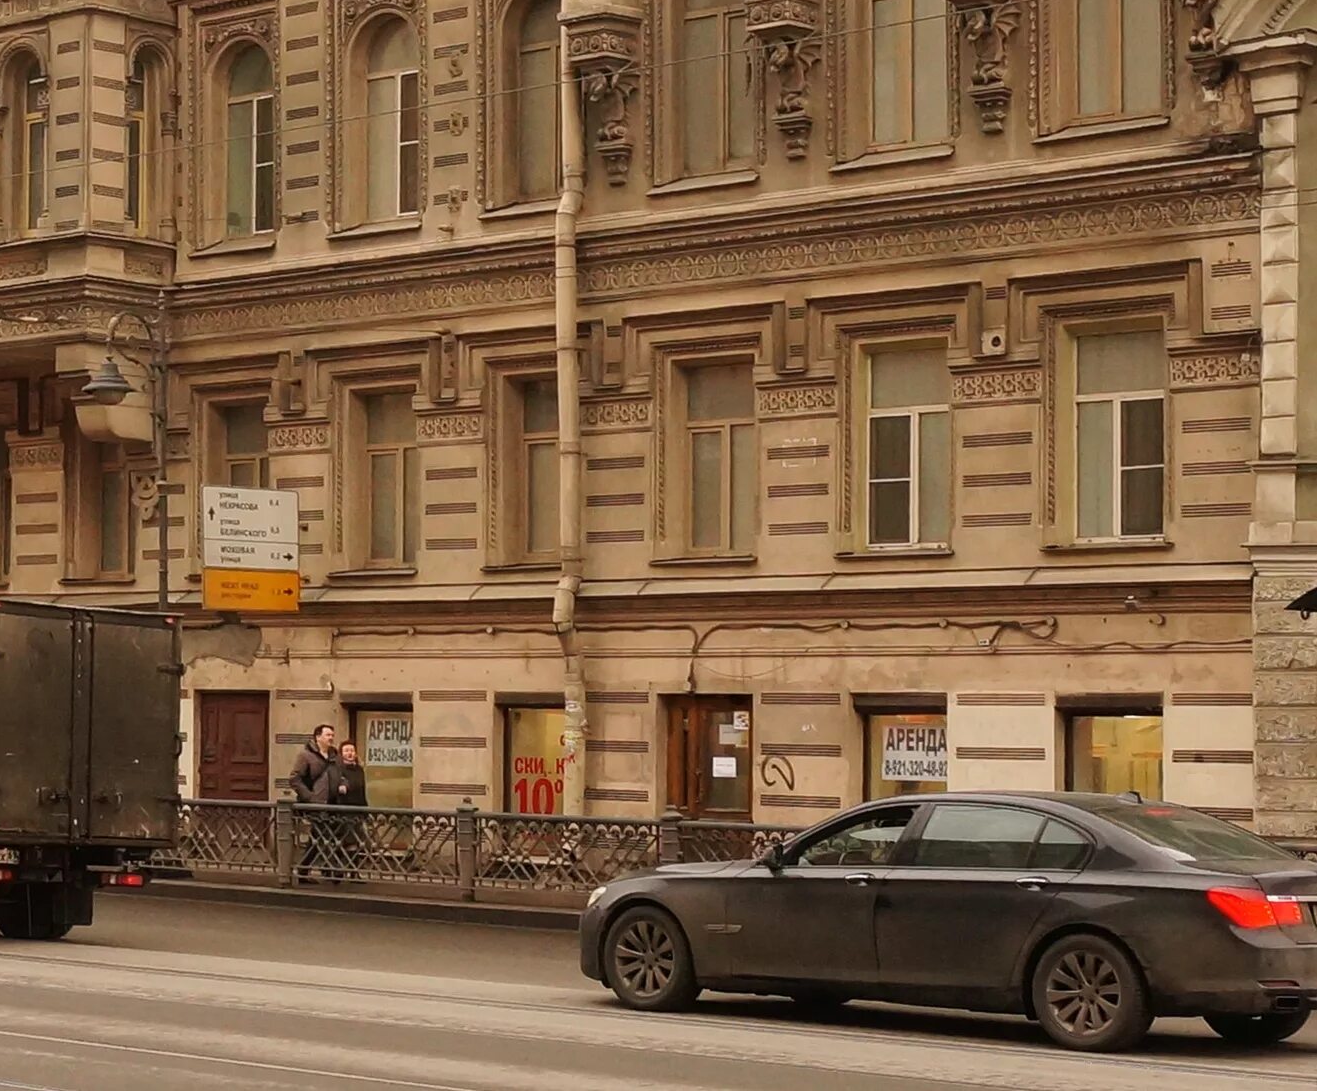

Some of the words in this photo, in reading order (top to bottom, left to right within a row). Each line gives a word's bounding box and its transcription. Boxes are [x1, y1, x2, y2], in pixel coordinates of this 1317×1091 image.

[219, 501, 259, 511] НЕКРАСОВА
[220, 528, 267, 538] БЕЛИНСКОГО
[220, 546, 256, 554] МОХОВАЯ
[886, 728, 947, 756] АРЕНДА
